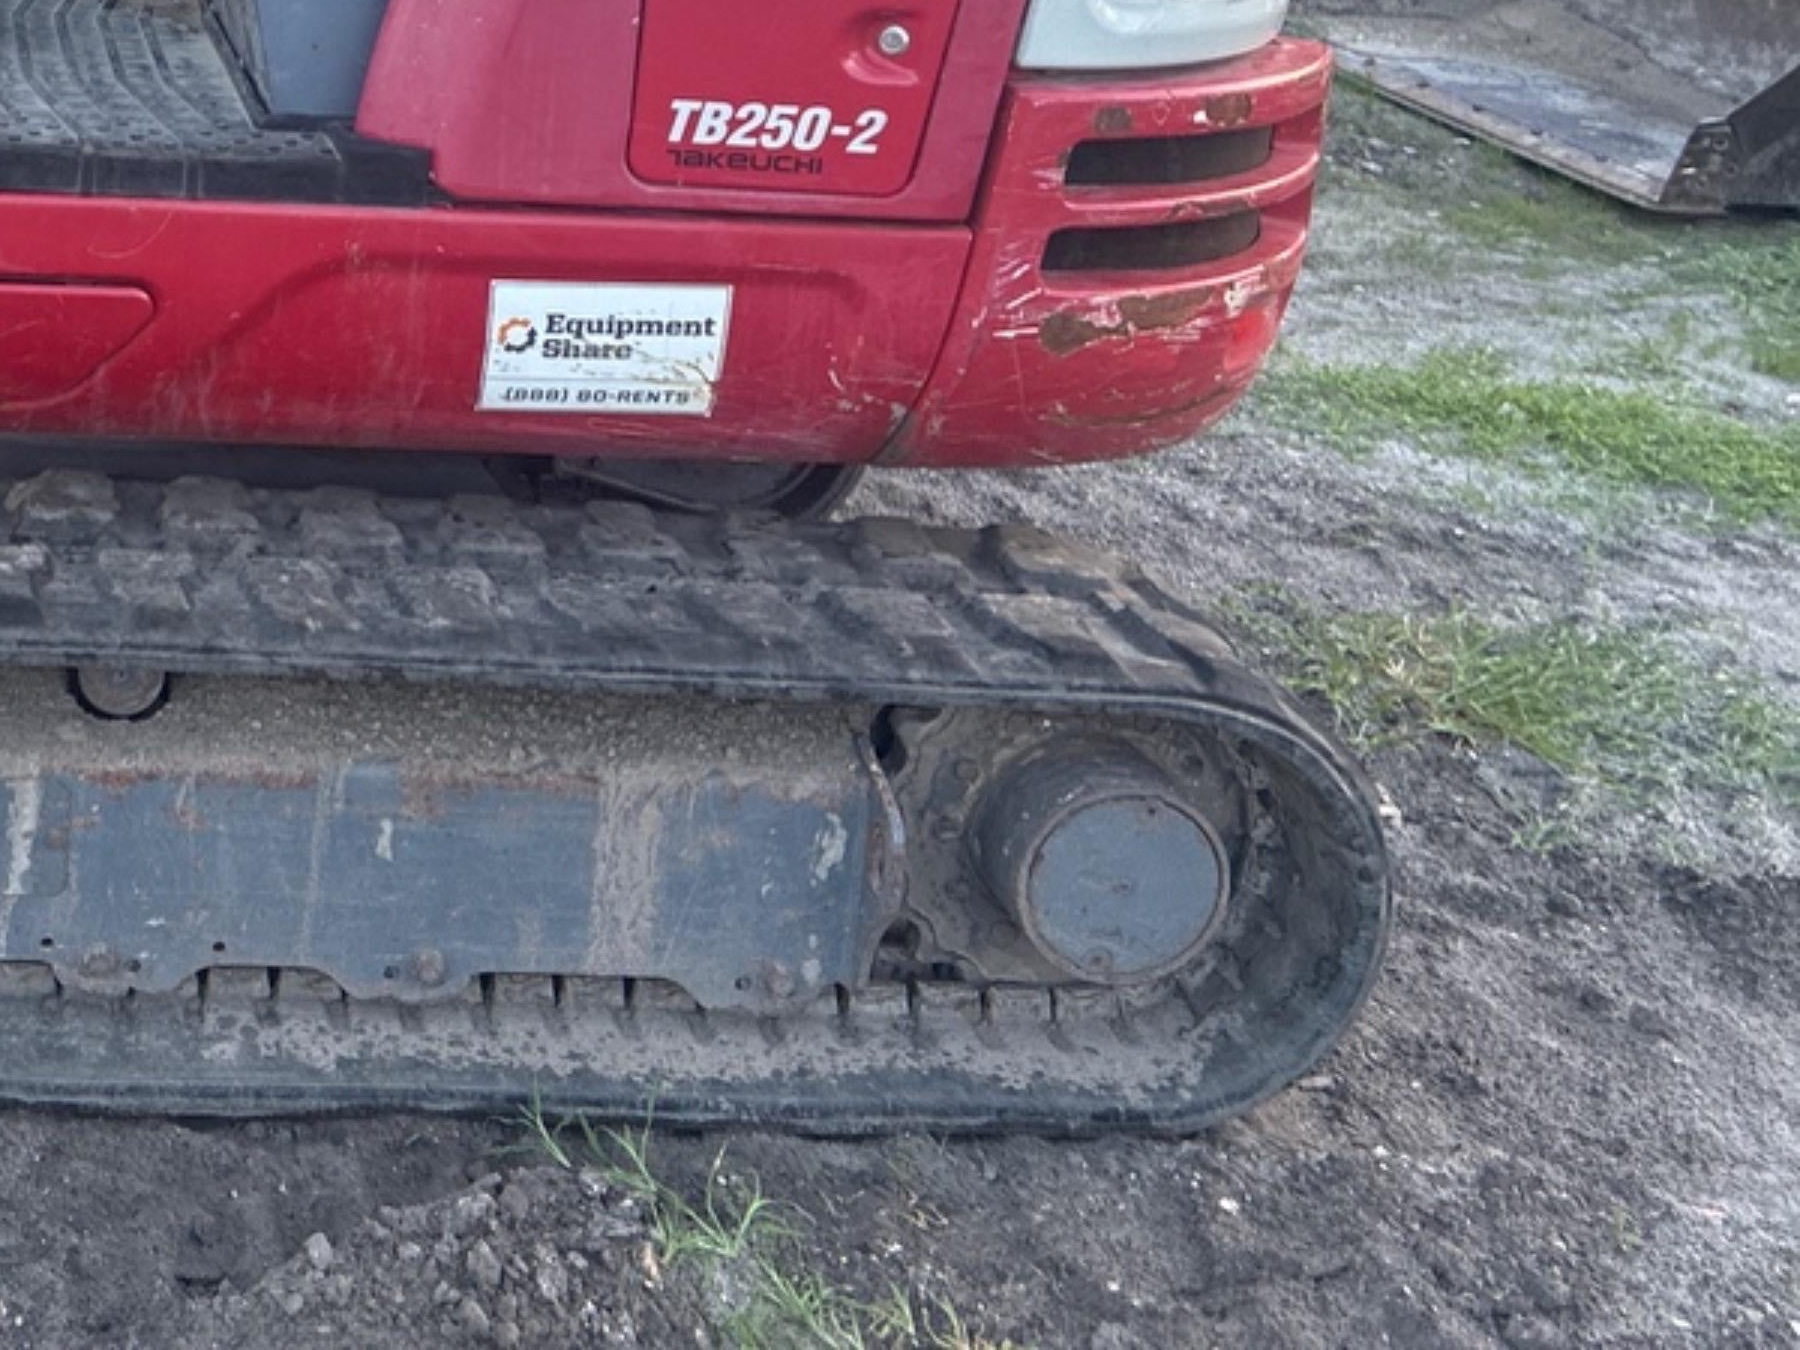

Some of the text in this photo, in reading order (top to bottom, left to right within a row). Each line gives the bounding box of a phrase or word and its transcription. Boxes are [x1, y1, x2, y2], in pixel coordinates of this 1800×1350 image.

[668, 99, 889, 154] TB250-2
[545, 314, 717, 340] Equipment
[542, 338, 634, 360] Share
